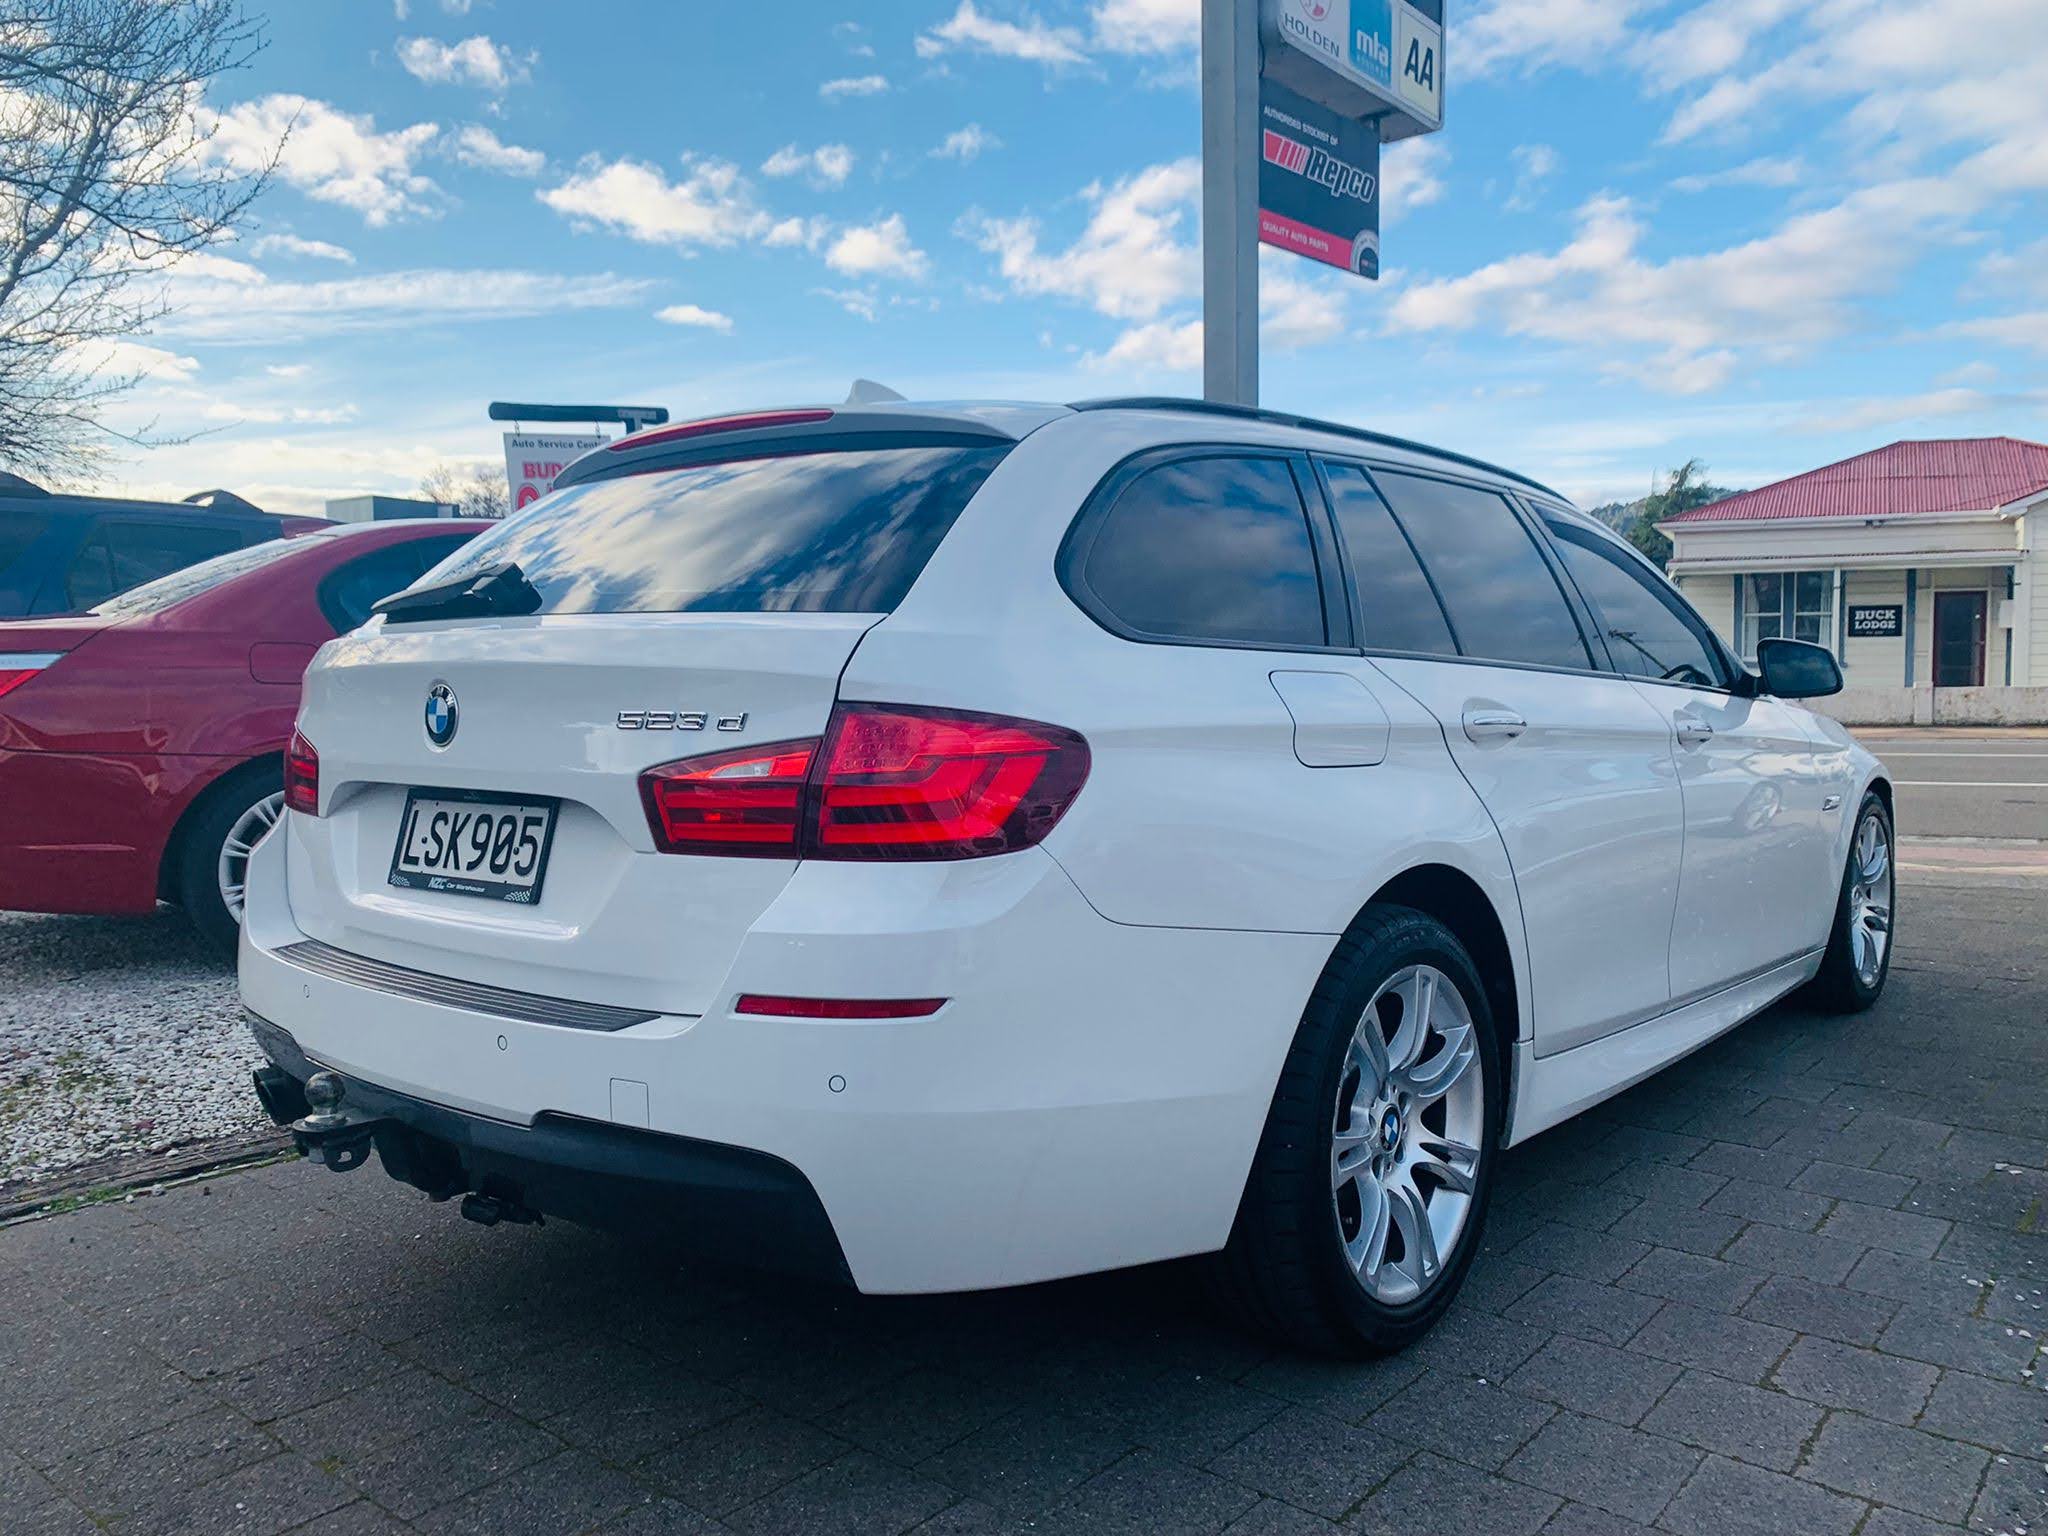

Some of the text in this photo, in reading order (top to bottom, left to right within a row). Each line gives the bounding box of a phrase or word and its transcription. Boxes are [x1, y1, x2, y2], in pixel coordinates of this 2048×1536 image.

[1284, 12, 1340, 57] HOLDEN
[1403, 36, 1435, 92] AA
[1306, 145, 1376, 204] Repco
[1262, 220, 1329, 252] QUALITY AUTO PARTS
[511, 439, 600, 449] Auto Service Cent
[523, 462, 565, 479] BUD
[1855, 609, 1896, 620] BUCK
[1855, 620, 1896, 630] LODGE
[615, 710, 749, 732] 523 d
[402, 809, 545, 877] LSK905
